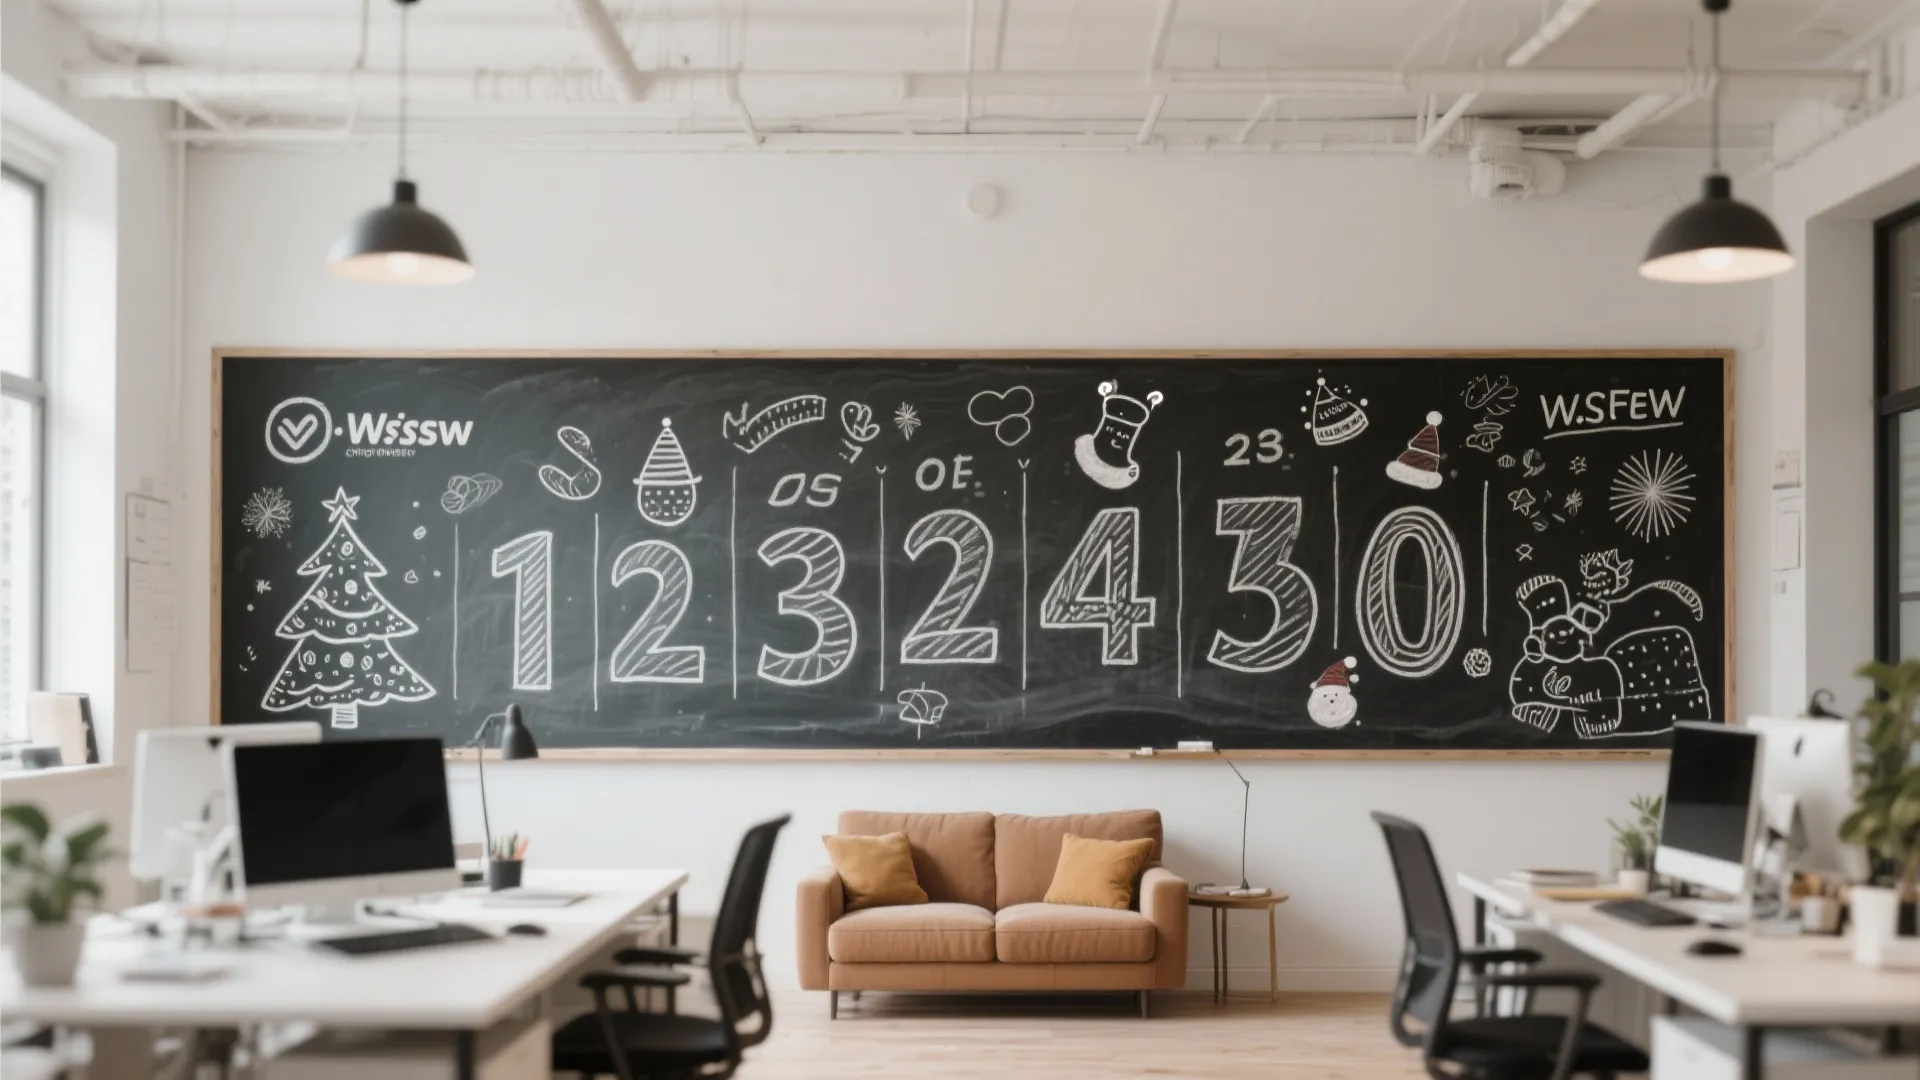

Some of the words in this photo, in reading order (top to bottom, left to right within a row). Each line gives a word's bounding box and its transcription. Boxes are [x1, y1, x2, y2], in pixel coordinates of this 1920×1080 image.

[492, 531, 552, 690] 1
[610, 540, 706, 682] 2
[757, 527, 858, 686] 3
[900, 509, 998, 664] 2
[1040, 507, 1156, 665] 4
[1207, 496, 1318, 673] 3
